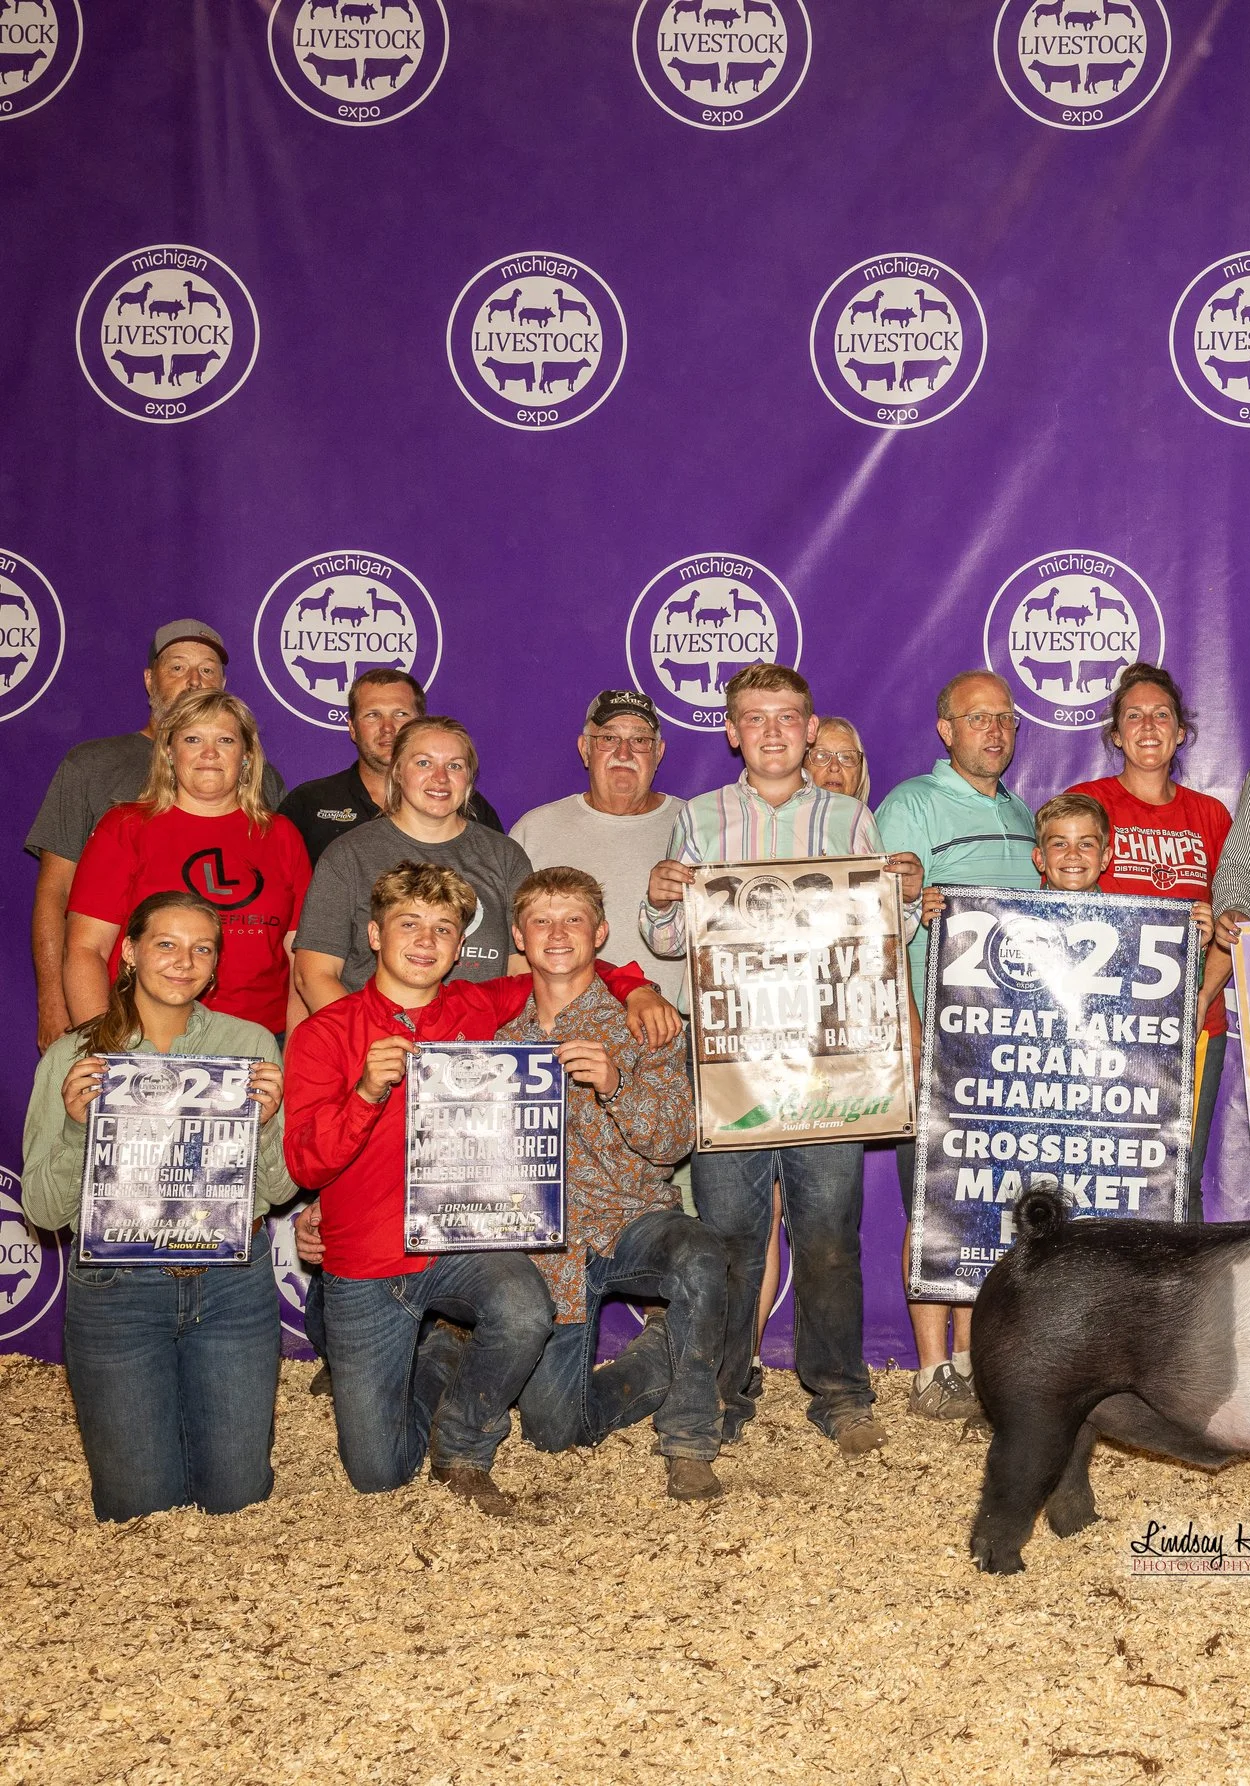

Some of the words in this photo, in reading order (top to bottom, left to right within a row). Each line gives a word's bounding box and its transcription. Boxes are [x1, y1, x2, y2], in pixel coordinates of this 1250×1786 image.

[296, 28, 421, 49] LIVESTOCK
[660, 33, 784, 53] LIVESTOCK
[1021, 35, 1143, 54] LIVESTOCK
[338, 105, 380, 121] expo
[702, 110, 743, 125] expo
[1063, 110, 1103, 125] expo
[132, 250, 207, 271] michigan
[501, 257, 577, 279] michigan
[864, 258, 939, 280] michigan
[104, 325, 229, 345] LIVESTOCK
[475, 332, 599, 352] LIVESTOCK
[838, 332, 959, 352] LIVESTOCK
[145, 403, 186, 418] expo
[517, 410, 558, 425] expo
[877, 408, 918, 423] expo
[313, 555, 391, 578] michigan
[680, 558, 753, 580] michigan
[1039, 555, 1115, 577] michigan
[283, 631, 414, 652] LIVESTOCK
[653, 633, 774, 653] LIVESTOCK
[1012, 632, 1136, 651] LIVESTOCK
[328, 710, 348, 722] ex
[1054, 709, 1095, 725] expo
[1161, 829, 1202, 838] BASKETBALL
[1114, 833, 1207, 866] CHAMPS
[1115, 865, 1150, 873] DISTRICT
[1180, 870, 1207, 879] LEAGUE
[712, 945, 884, 985] RESERVE
[702, 980, 897, 1030] CHAMPION
[939, 1005, 1058, 1040] GREAT
[1067, 1012, 1180, 1045] LAKES
[991, 1044, 1126, 1079] GRAND
[954, 1077, 1159, 1115] CHAMPION
[415, 1106, 558, 1131] CHAMPION
[781, 1122, 810, 1132] Swine
[812, 1119, 845, 1130] Farms
[97, 1117, 250, 1144] CHAMPION
[94, 1143, 185, 1168] MICHIGAN
[200, 1145, 248, 1168] BRED
[514, 1136, 558, 1157] BRED
[942, 1129, 1166, 1168] CROSSBRED
[131, 1168, 193, 1182] DIVISION
[159, 1184, 197, 1197] MARKET
[206, 1185, 245, 1198] BARROW
[437, 1203, 492, 1213] FORMULA
[495, 1202, 510, 1211] OF
[103, 1228, 226, 1250] CHAMPIONS
[960, 1246, 1008, 1261] BELIE
[955, 1267, 981, 1277] OUR
